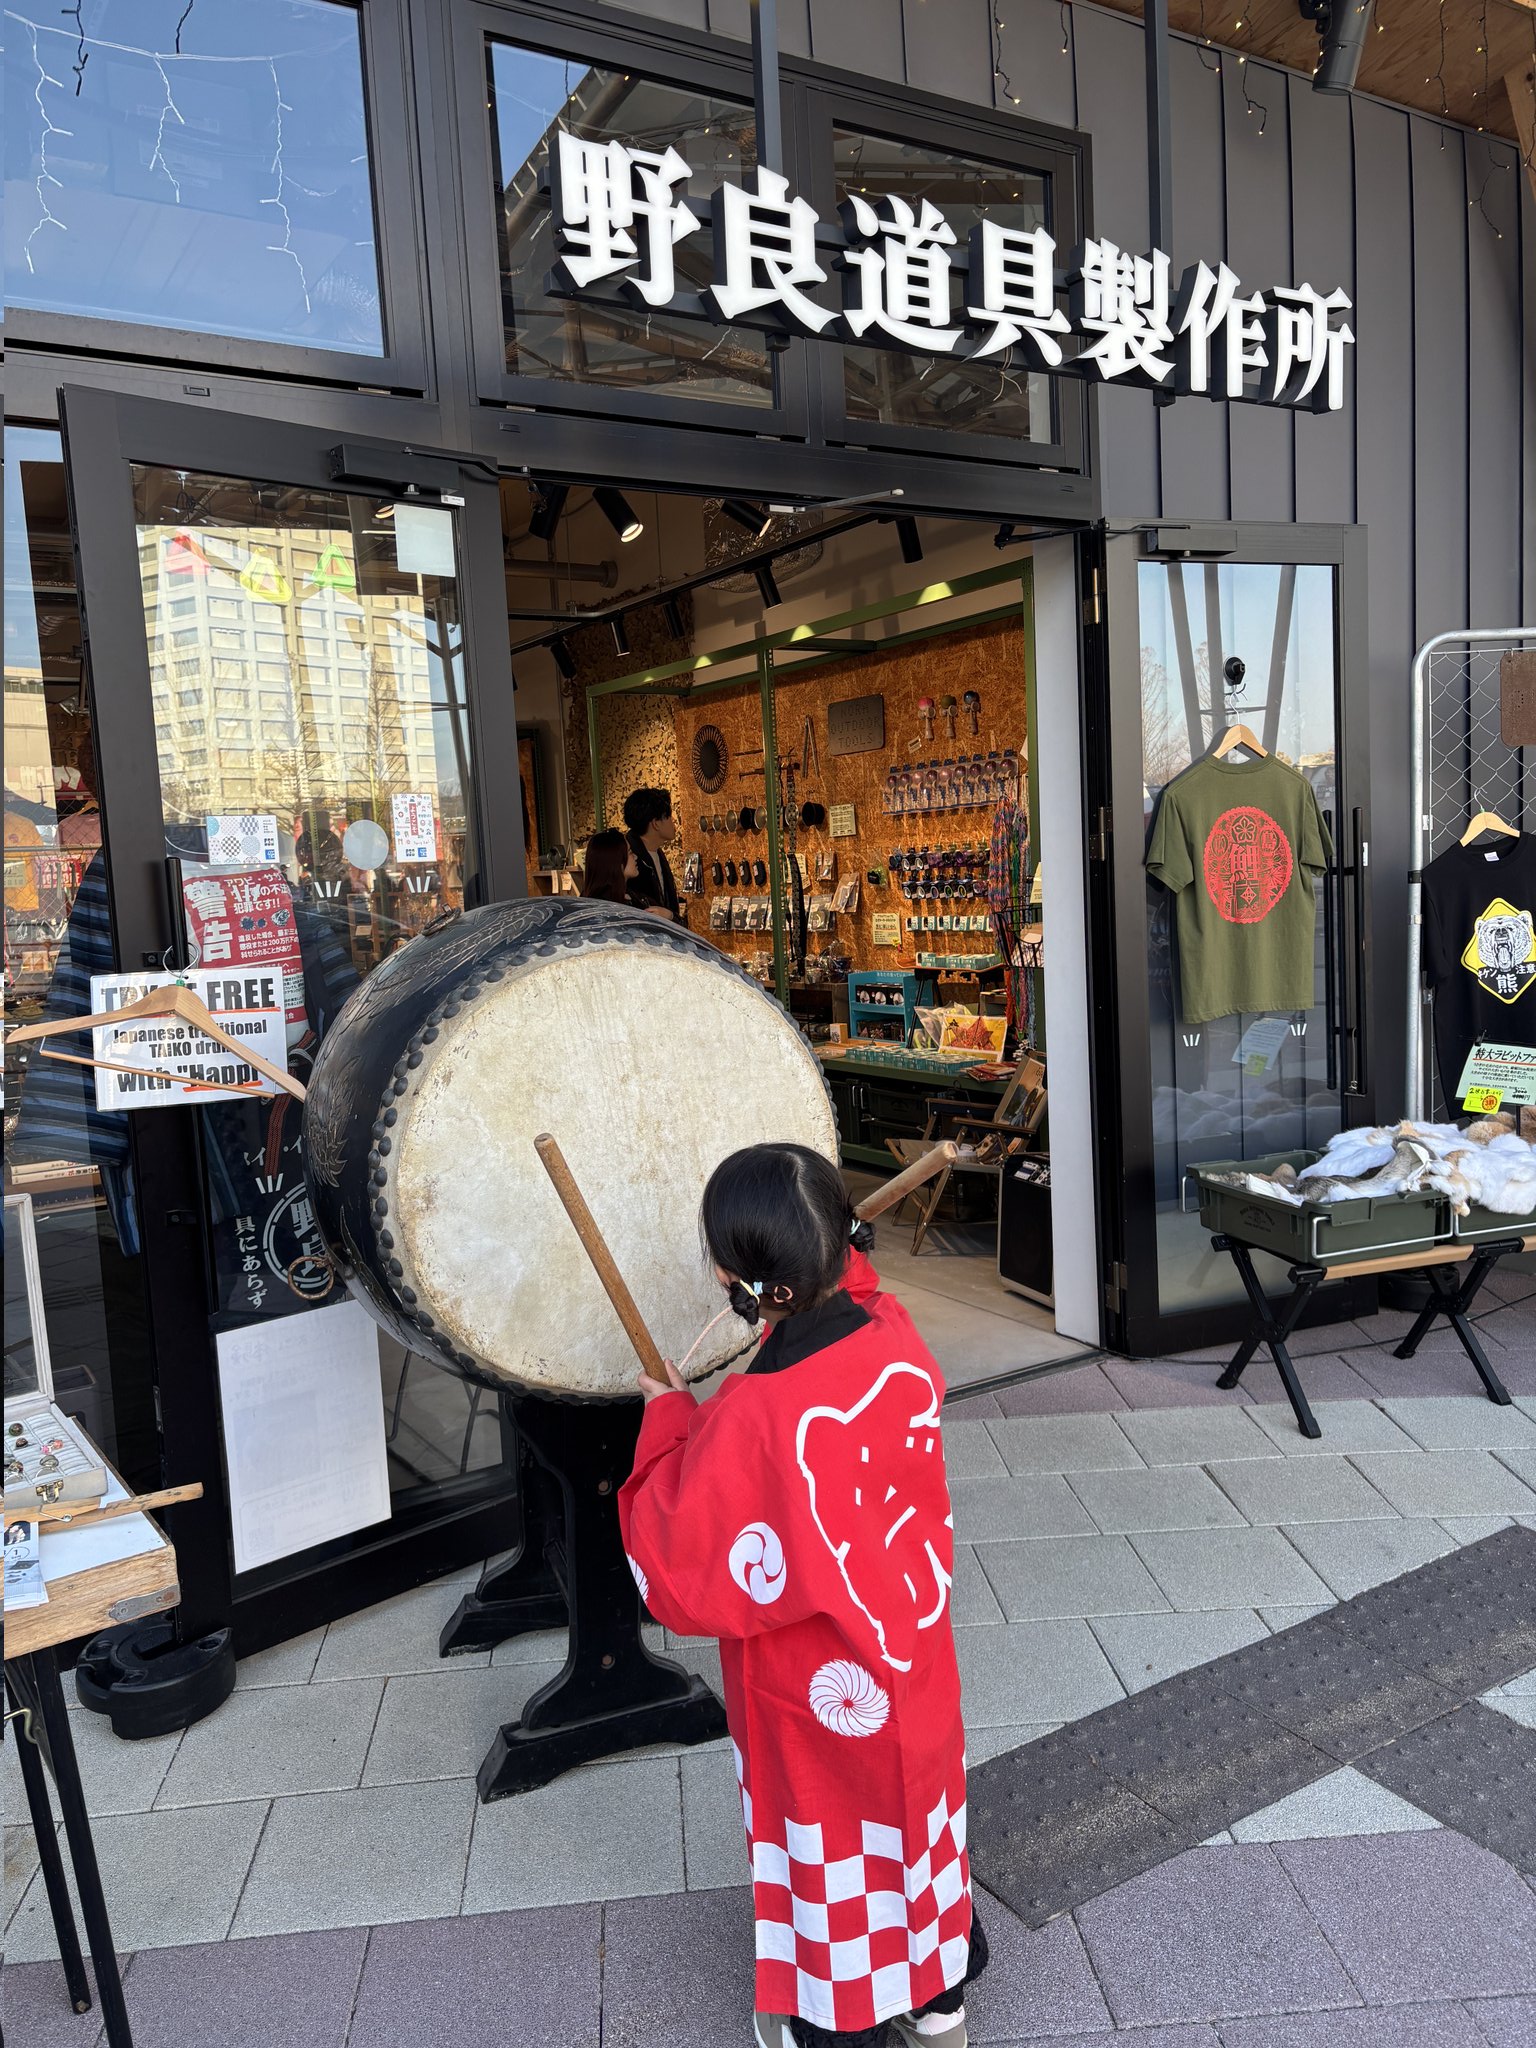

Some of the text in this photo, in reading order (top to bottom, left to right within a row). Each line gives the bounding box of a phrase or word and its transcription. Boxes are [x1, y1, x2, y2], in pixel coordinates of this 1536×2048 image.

[558, 130, 1355, 411] 野良道具製作所
[183, 879, 233, 963] 警告
[207, 978, 275, 1012] FREE
[1496, 973, 1519, 994] 熊
[113, 1027, 185, 1045] Japanese
